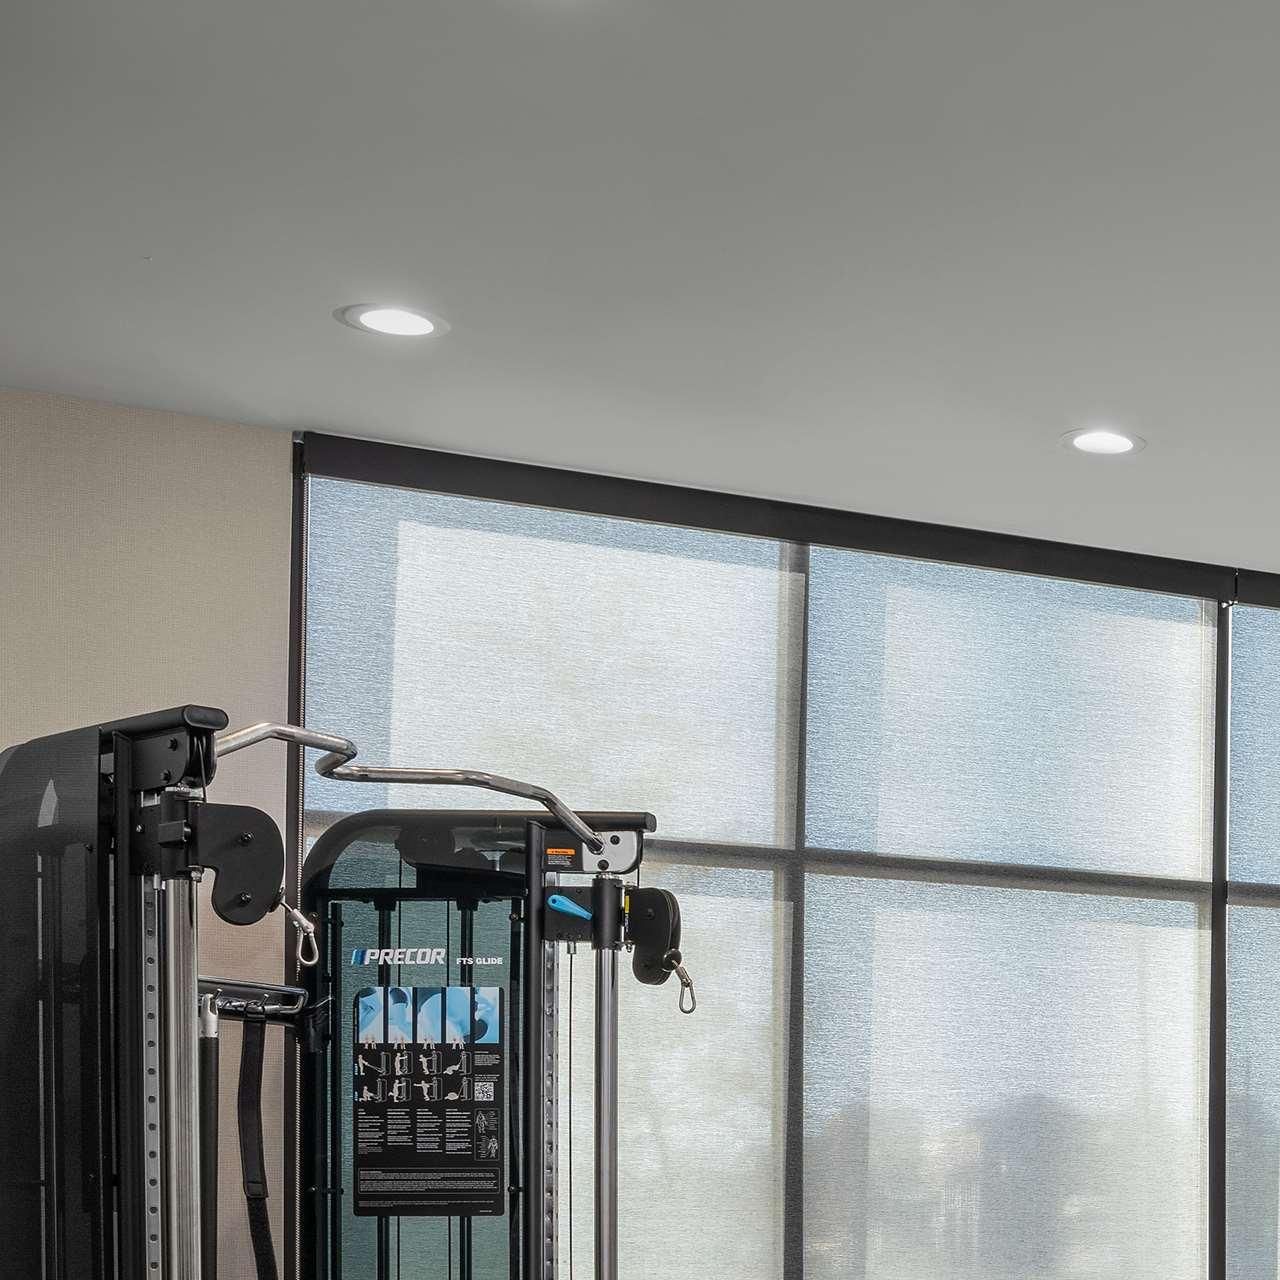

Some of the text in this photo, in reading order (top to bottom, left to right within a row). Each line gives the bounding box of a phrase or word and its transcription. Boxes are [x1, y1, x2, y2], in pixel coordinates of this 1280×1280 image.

[364, 948, 446, 965] PRECOR
[456, 957, 504, 965] FTS GLIDE
